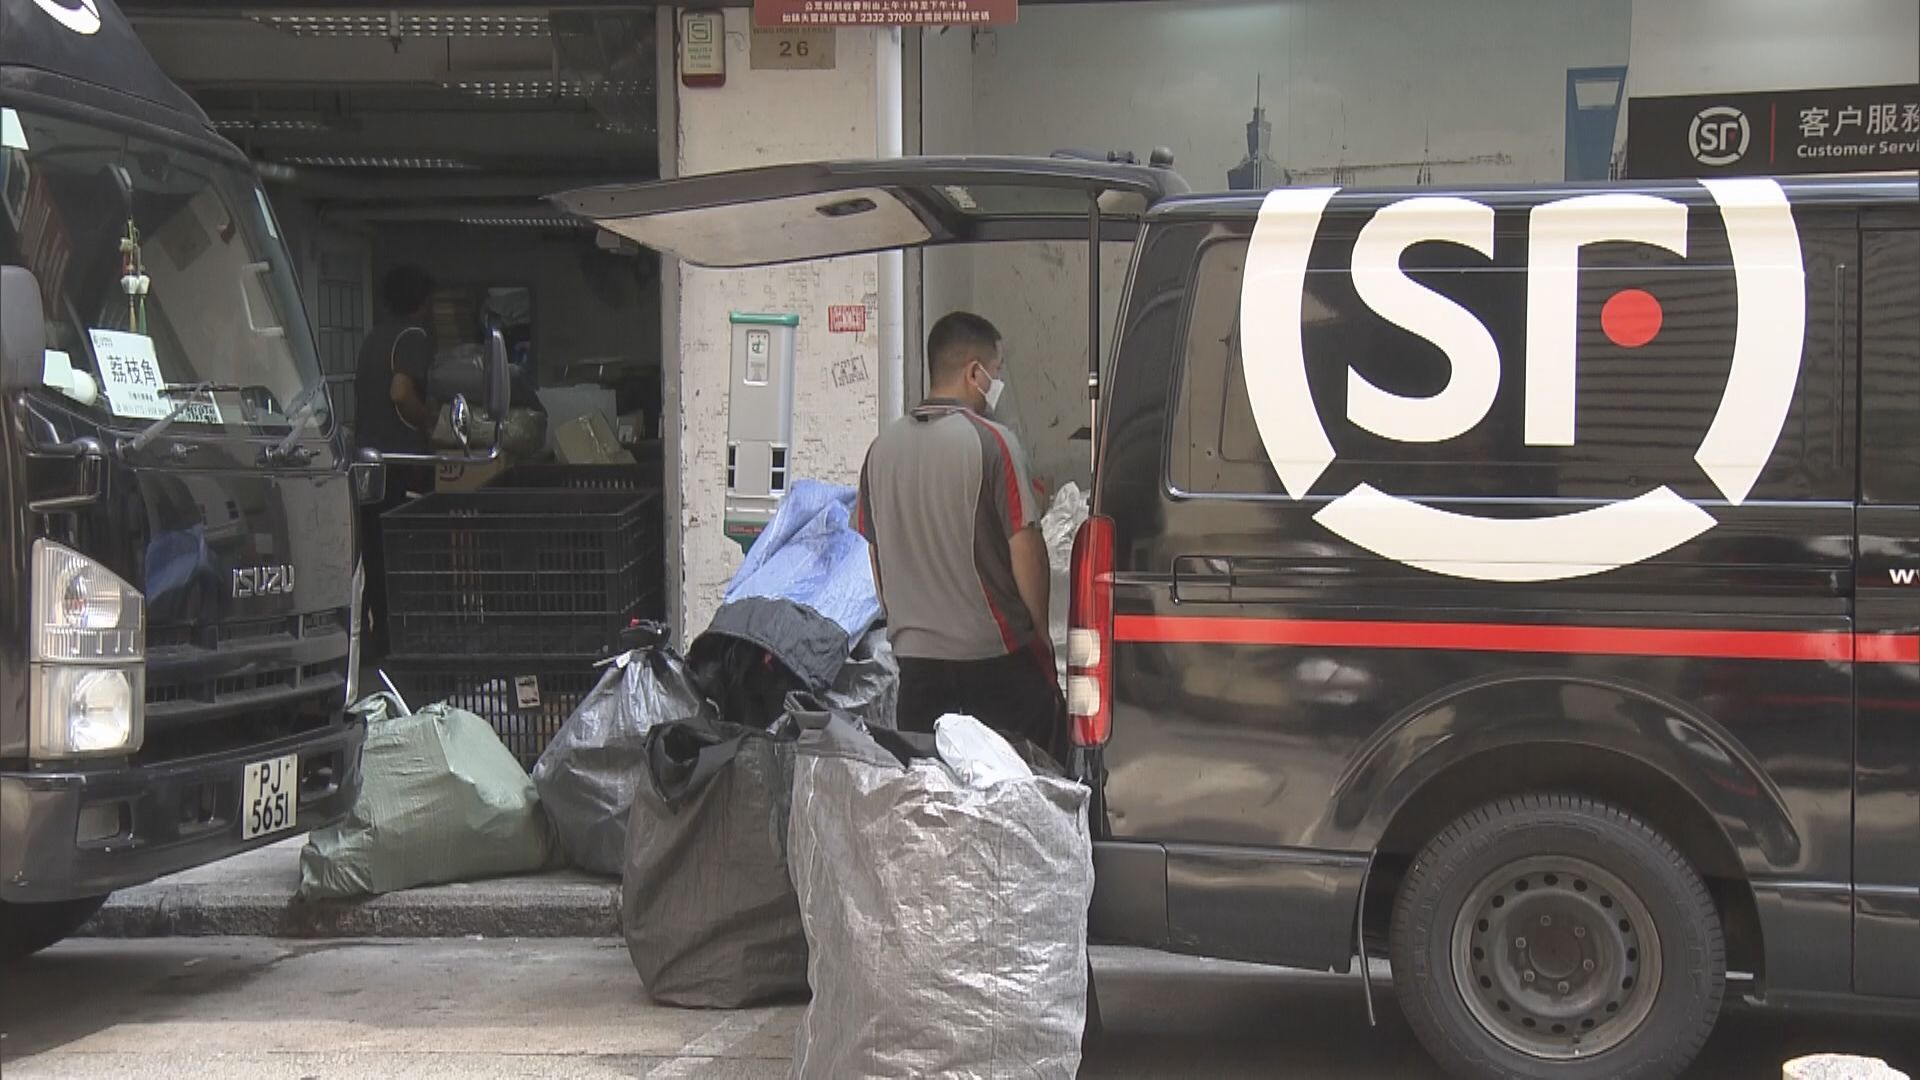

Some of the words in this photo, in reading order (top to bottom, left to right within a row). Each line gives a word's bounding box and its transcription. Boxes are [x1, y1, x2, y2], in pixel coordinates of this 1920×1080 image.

[860, 13, 884, 22] 2332
[887, 13, 912, 22] 3700
[779, 41, 809, 57] 26
[1797, 144, 1876, 158] Customer
[108, 355, 157, 387] 荔枝角
[232, 565, 295, 598] ISUZU
[260, 760, 282, 798] PJ
[252, 791, 288, 834] 5651
